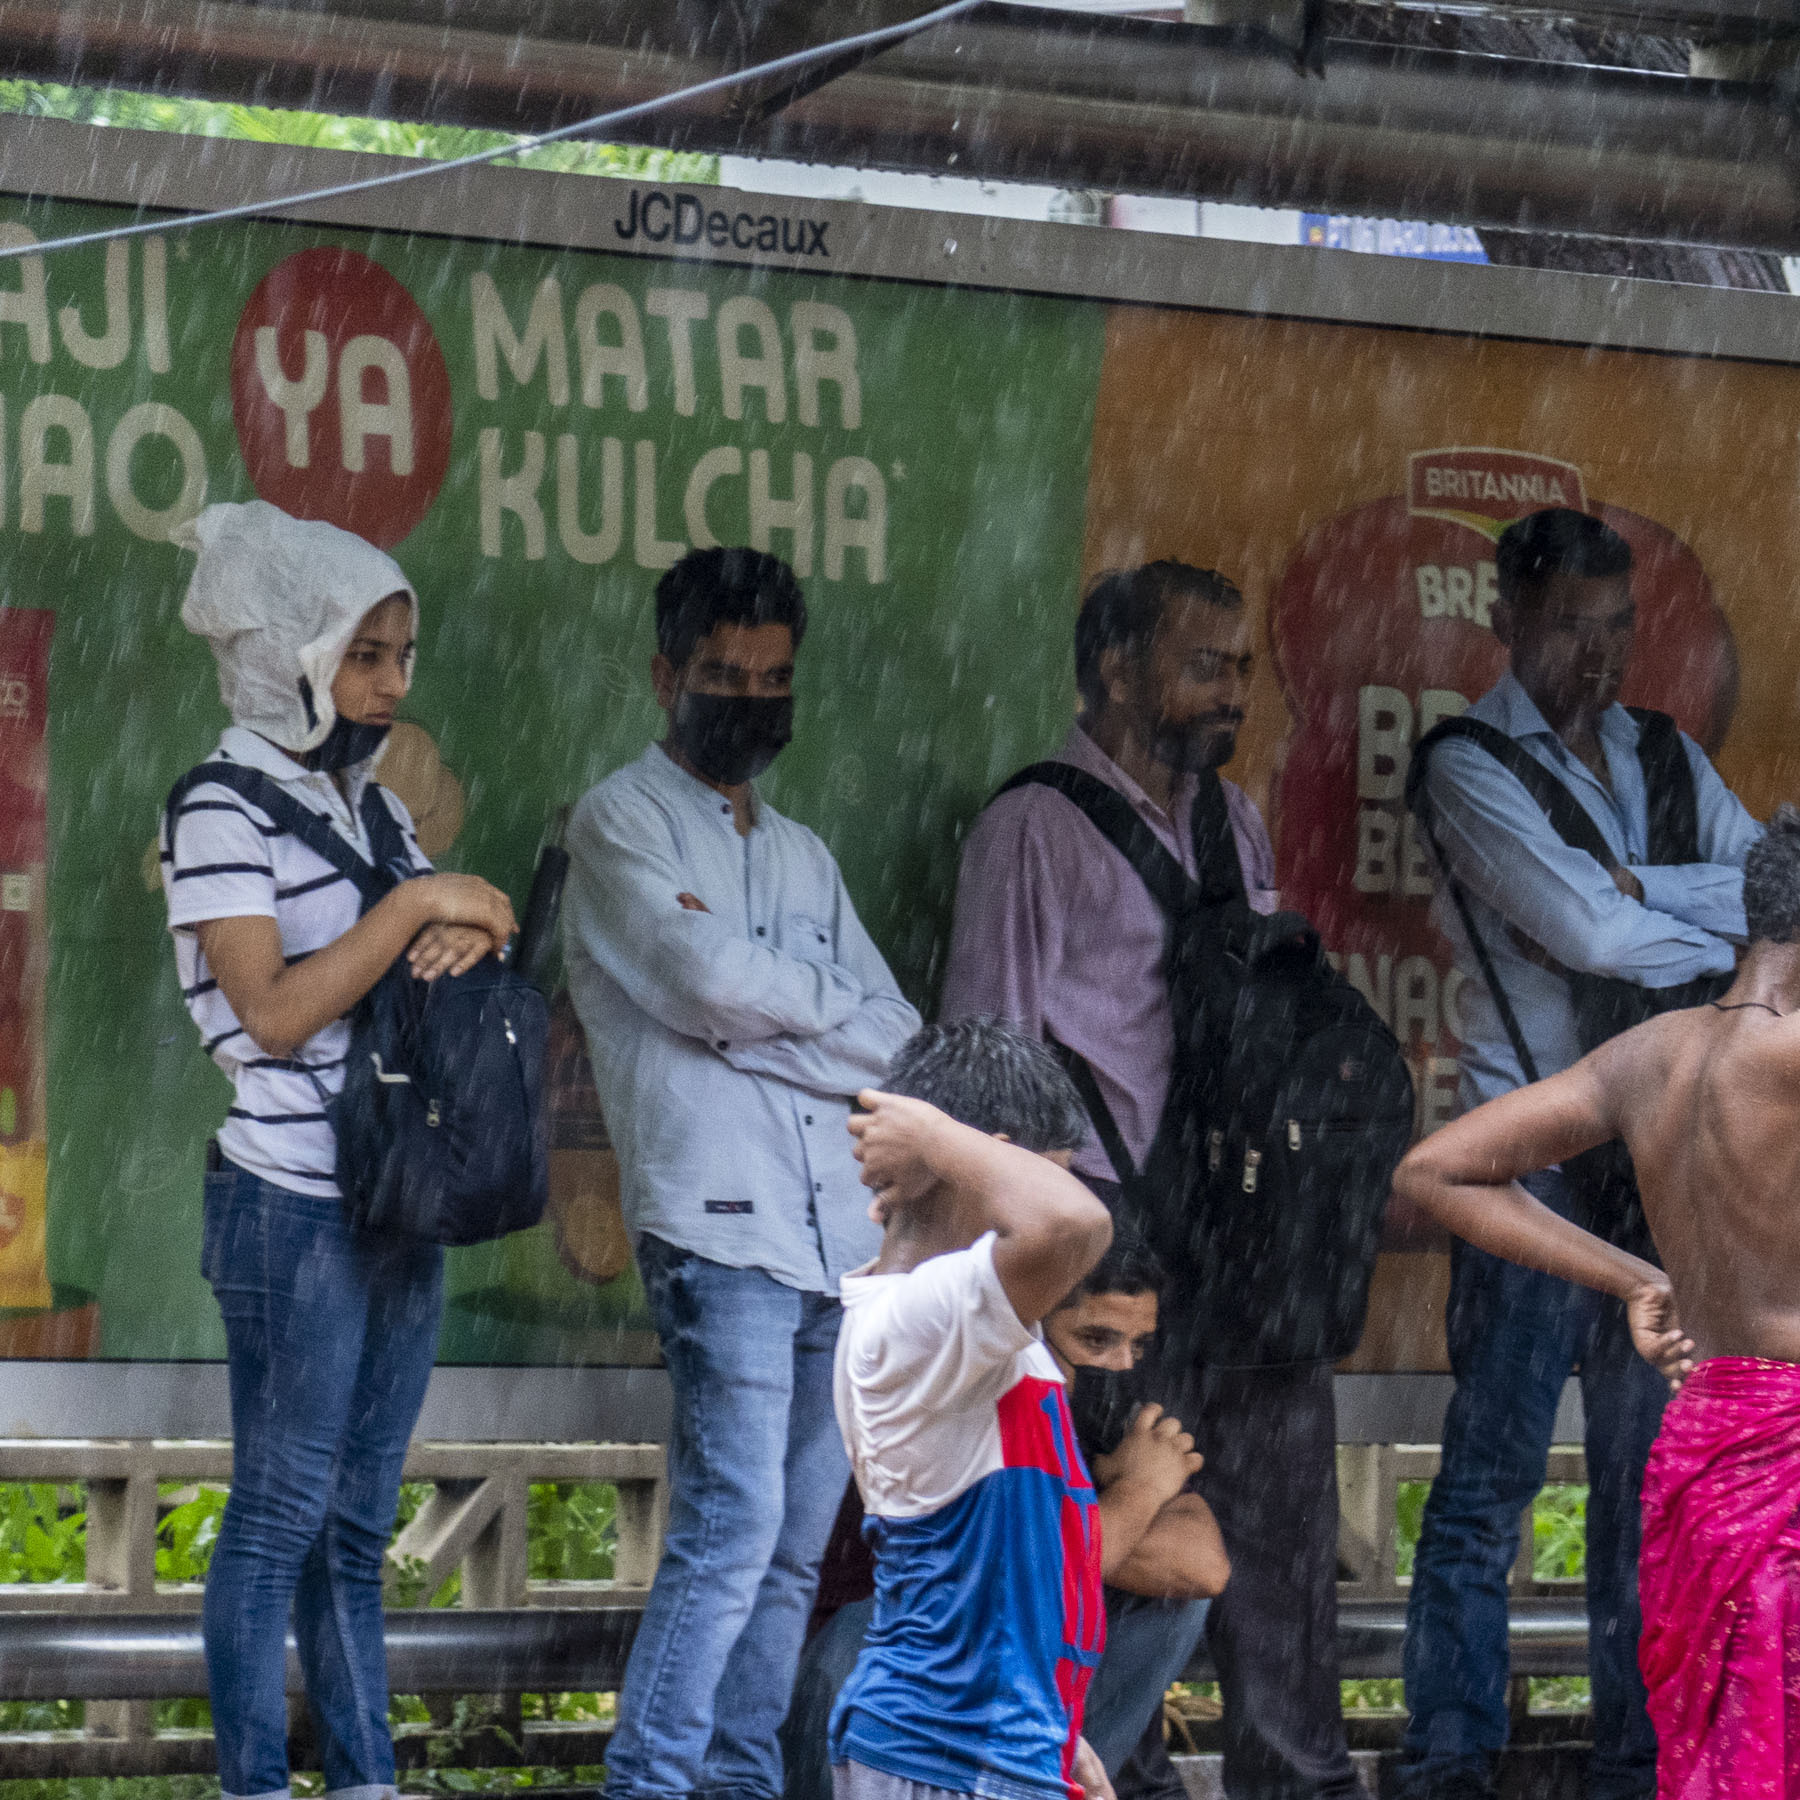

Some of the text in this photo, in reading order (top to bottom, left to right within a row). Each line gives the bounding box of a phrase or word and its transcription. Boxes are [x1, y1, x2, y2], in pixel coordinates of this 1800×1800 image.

[614, 189, 831, 257] JCDecaux
[255, 326, 413, 476] YA
[470, 271, 862, 430] MATAR
[0, 394, 207, 541] AO
[1424, 467, 1568, 504] BRITANNIA
